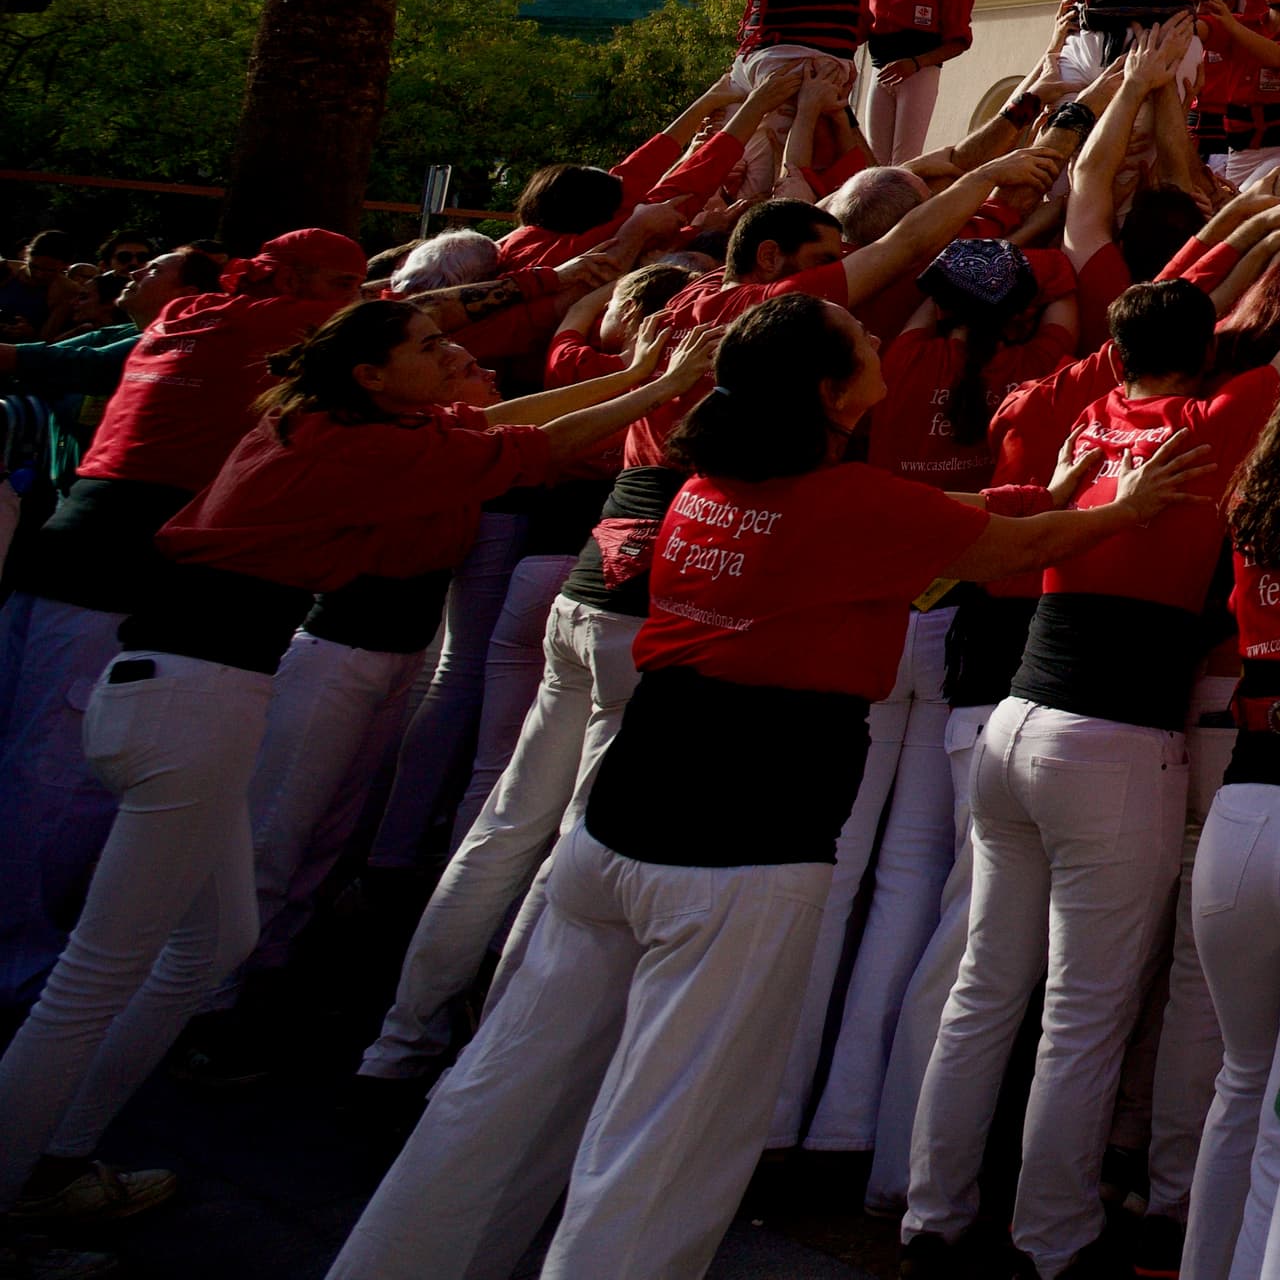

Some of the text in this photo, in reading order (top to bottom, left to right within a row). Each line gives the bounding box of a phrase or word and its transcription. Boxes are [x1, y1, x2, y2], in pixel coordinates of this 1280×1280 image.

[673, 489, 783, 540] nascuts per
[661, 526, 746, 582] fer pinya
